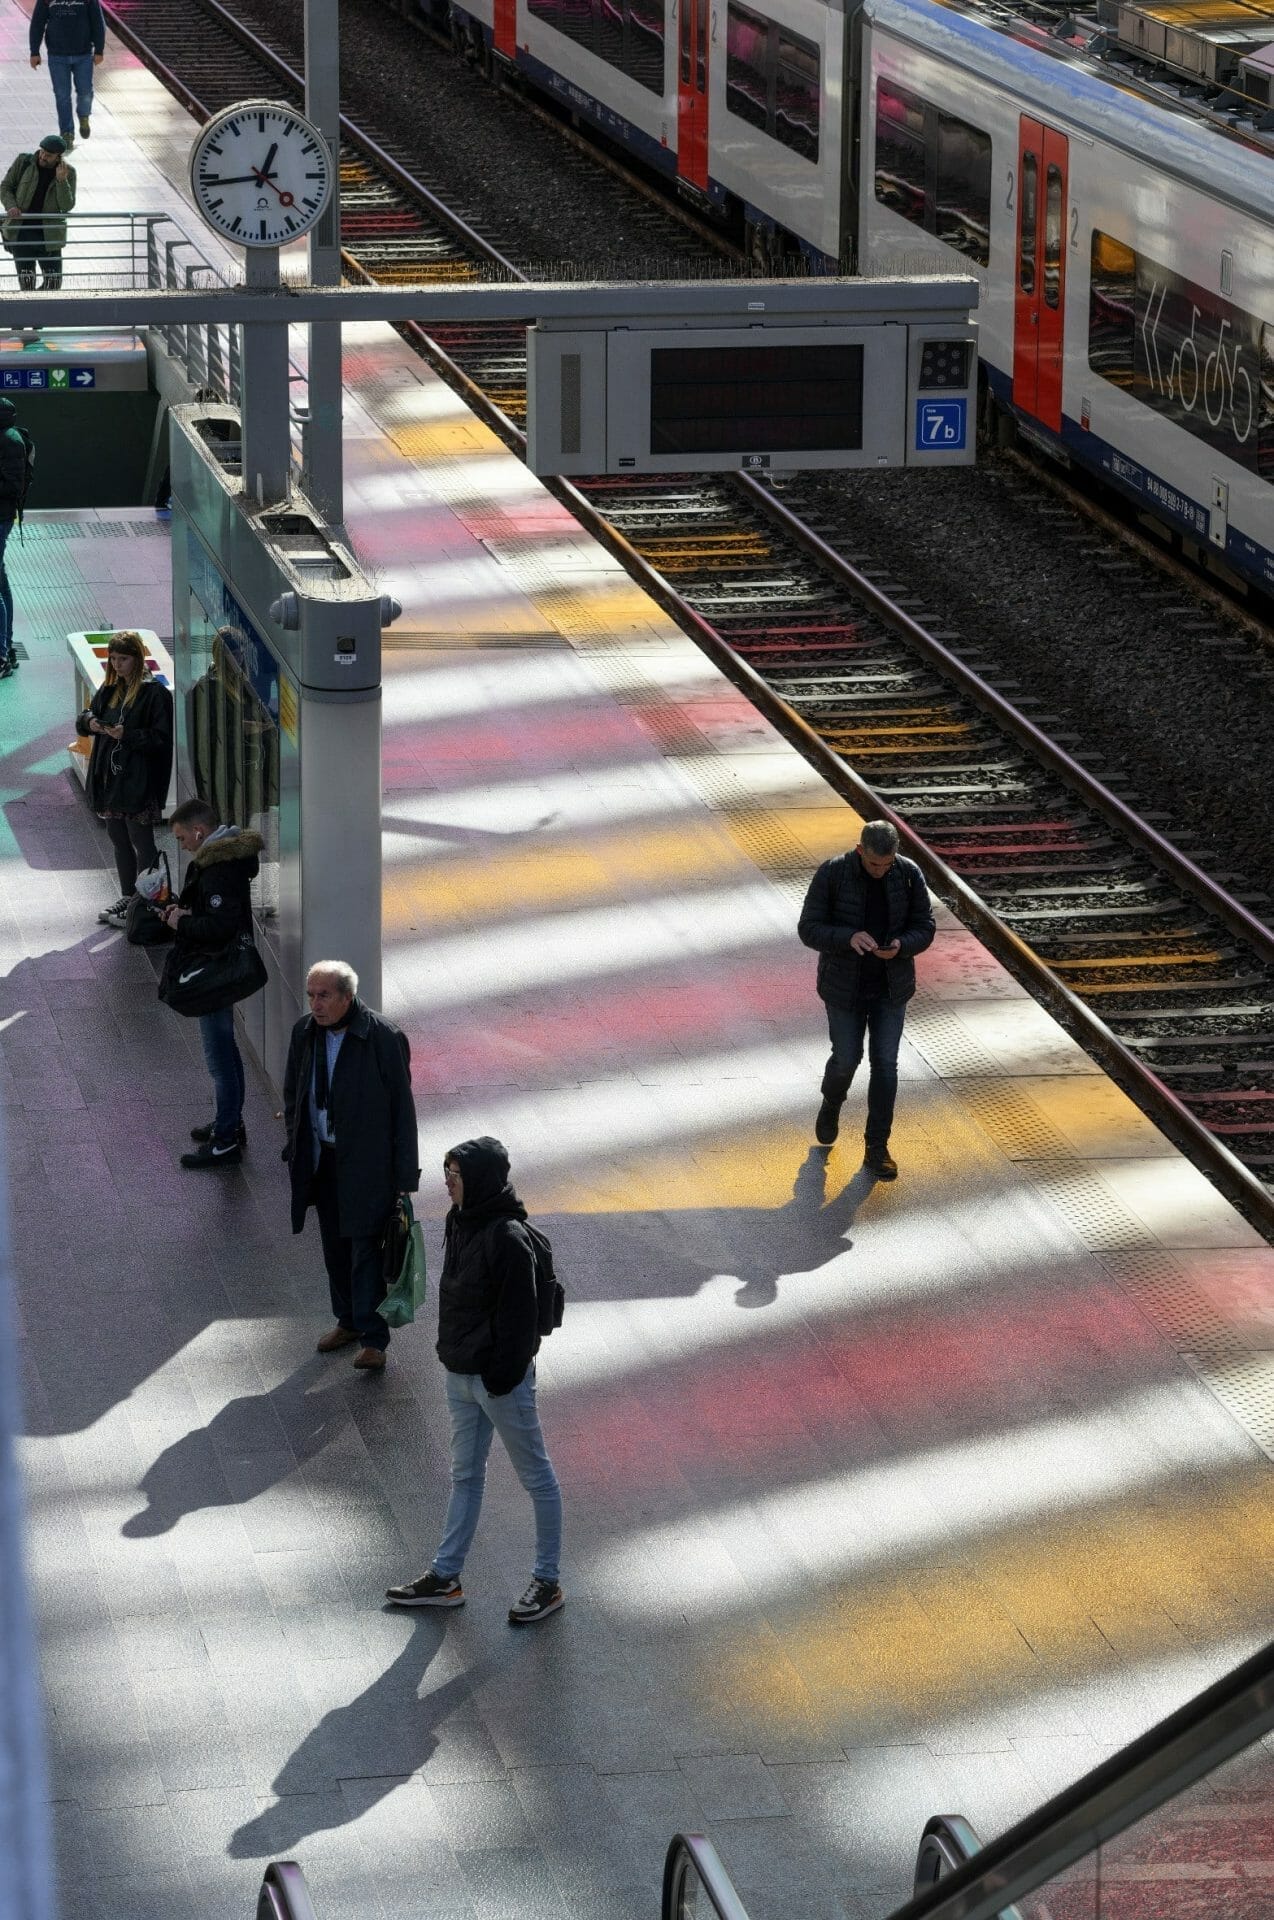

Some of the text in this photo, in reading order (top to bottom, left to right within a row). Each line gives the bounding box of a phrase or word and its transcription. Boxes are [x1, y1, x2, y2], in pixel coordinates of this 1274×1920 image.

[1006, 170, 1014, 211] 2
[1070, 207, 1079, 248] 2
[927, 415, 955, 440] 7b
